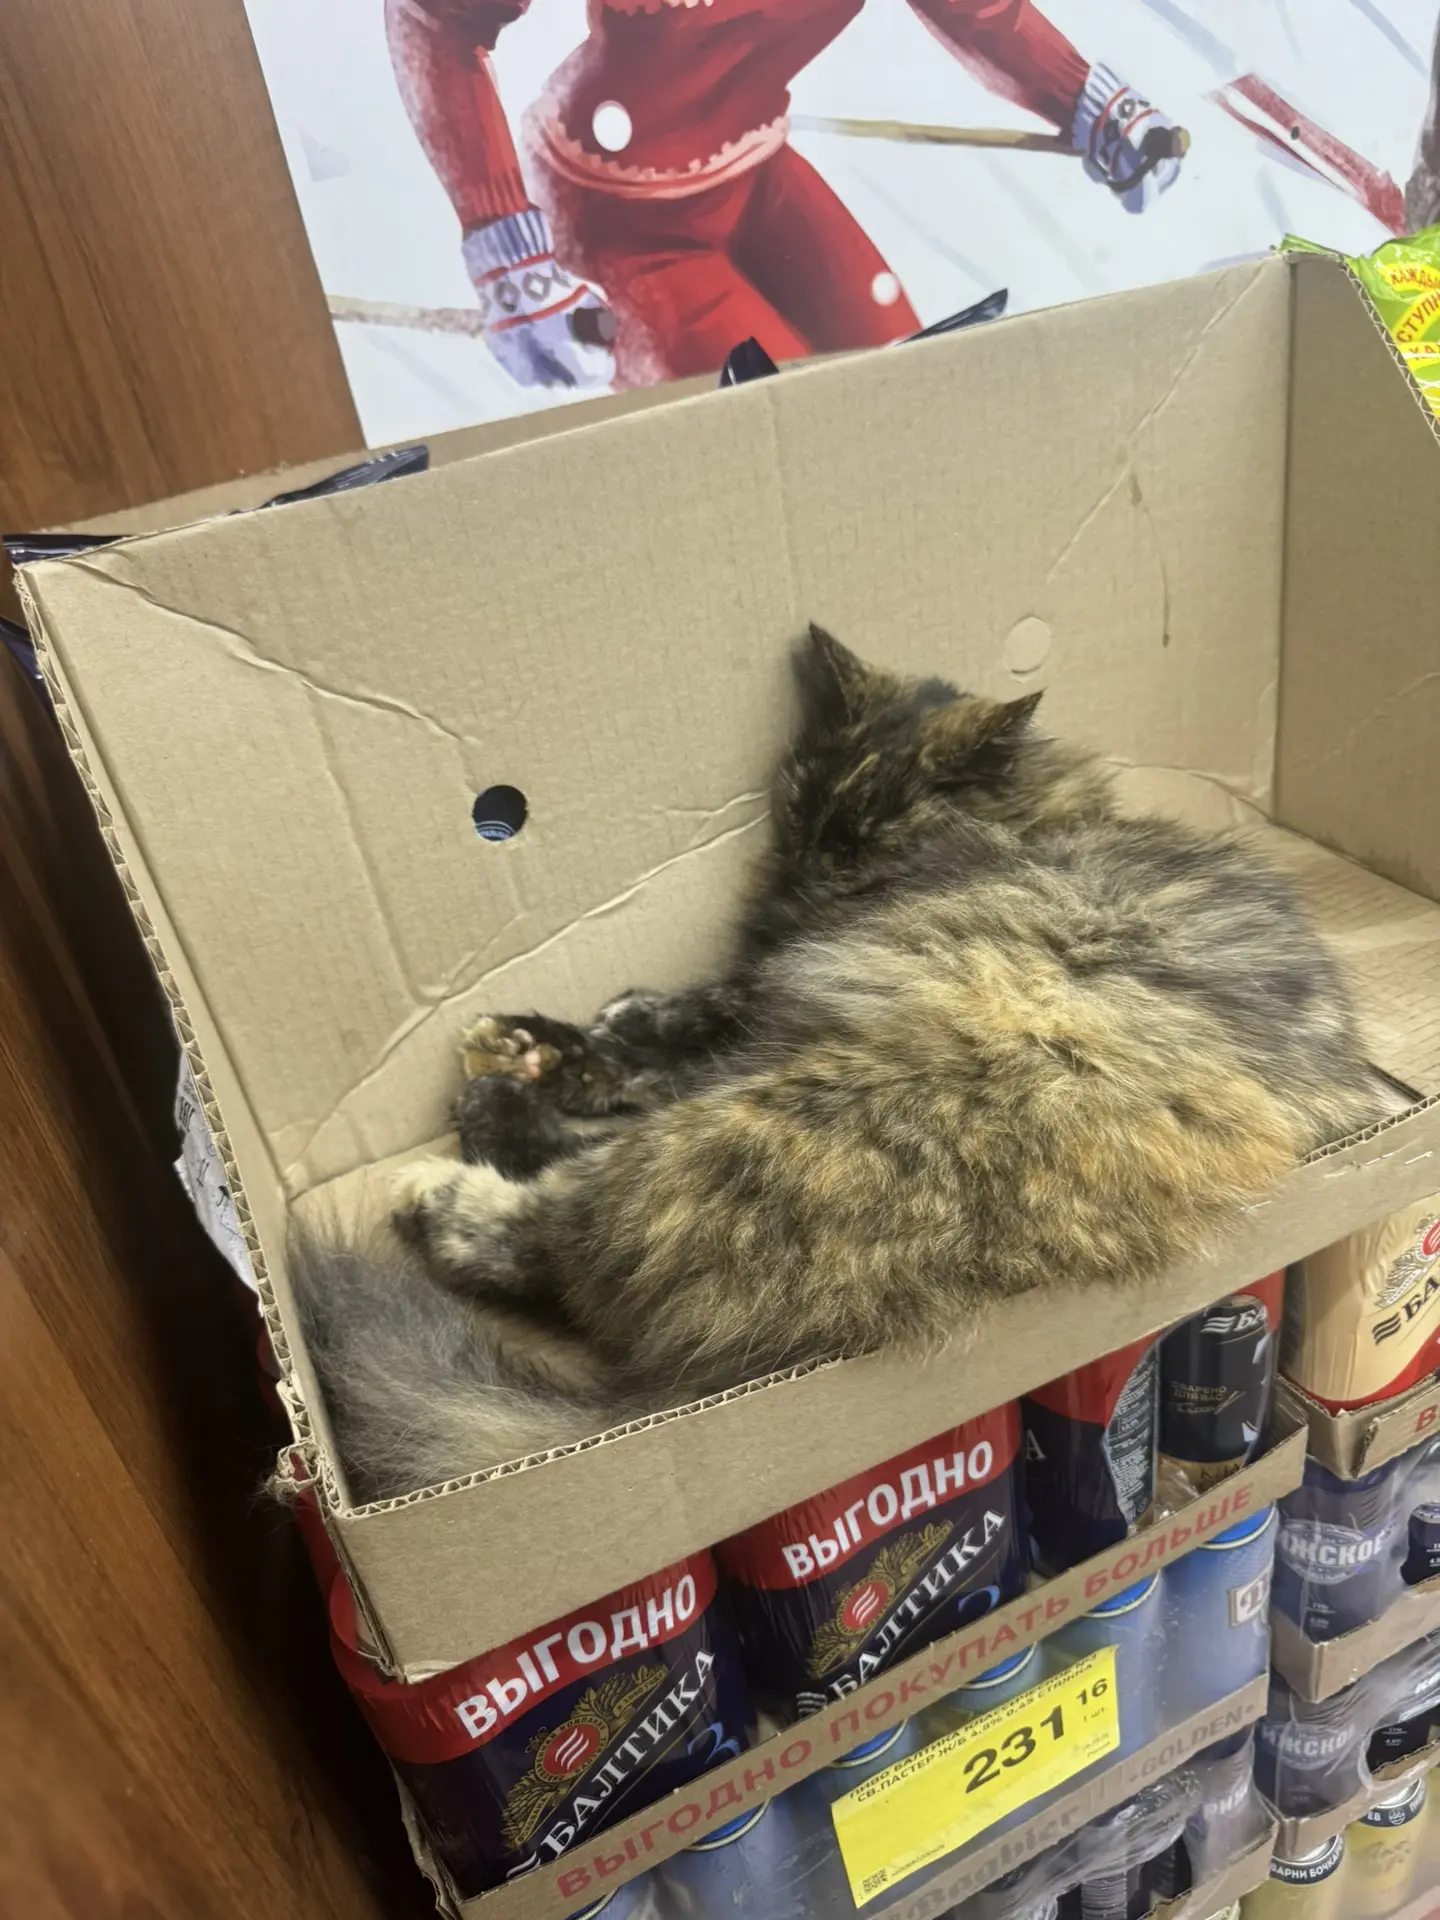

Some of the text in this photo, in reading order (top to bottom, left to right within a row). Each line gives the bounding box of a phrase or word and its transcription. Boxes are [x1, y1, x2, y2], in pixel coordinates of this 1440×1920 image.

[782, 1441, 993, 1579] ВЫГОДНО
[453, 1574, 697, 1739] ВЫГОДНО
[829, 1509, 1007, 1699] БАЛТИКА
[541, 1648, 716, 1857] БАЛТИКА
[556, 1740, 813, 1901] ВЫГОДНО
[829, 1593, 1071, 1744] ПОКУПАТЬ
[1084, 1481, 1255, 1598] БОЛЬШЕ
[892, 1730, 961, 1774] БАЛТИКА
[963, 1677, 1109, 1795] 231 16
[857, 1755, 934, 1803] СВ.ПАСТЕР
[937, 1735, 967, 1761] Ж/Б
